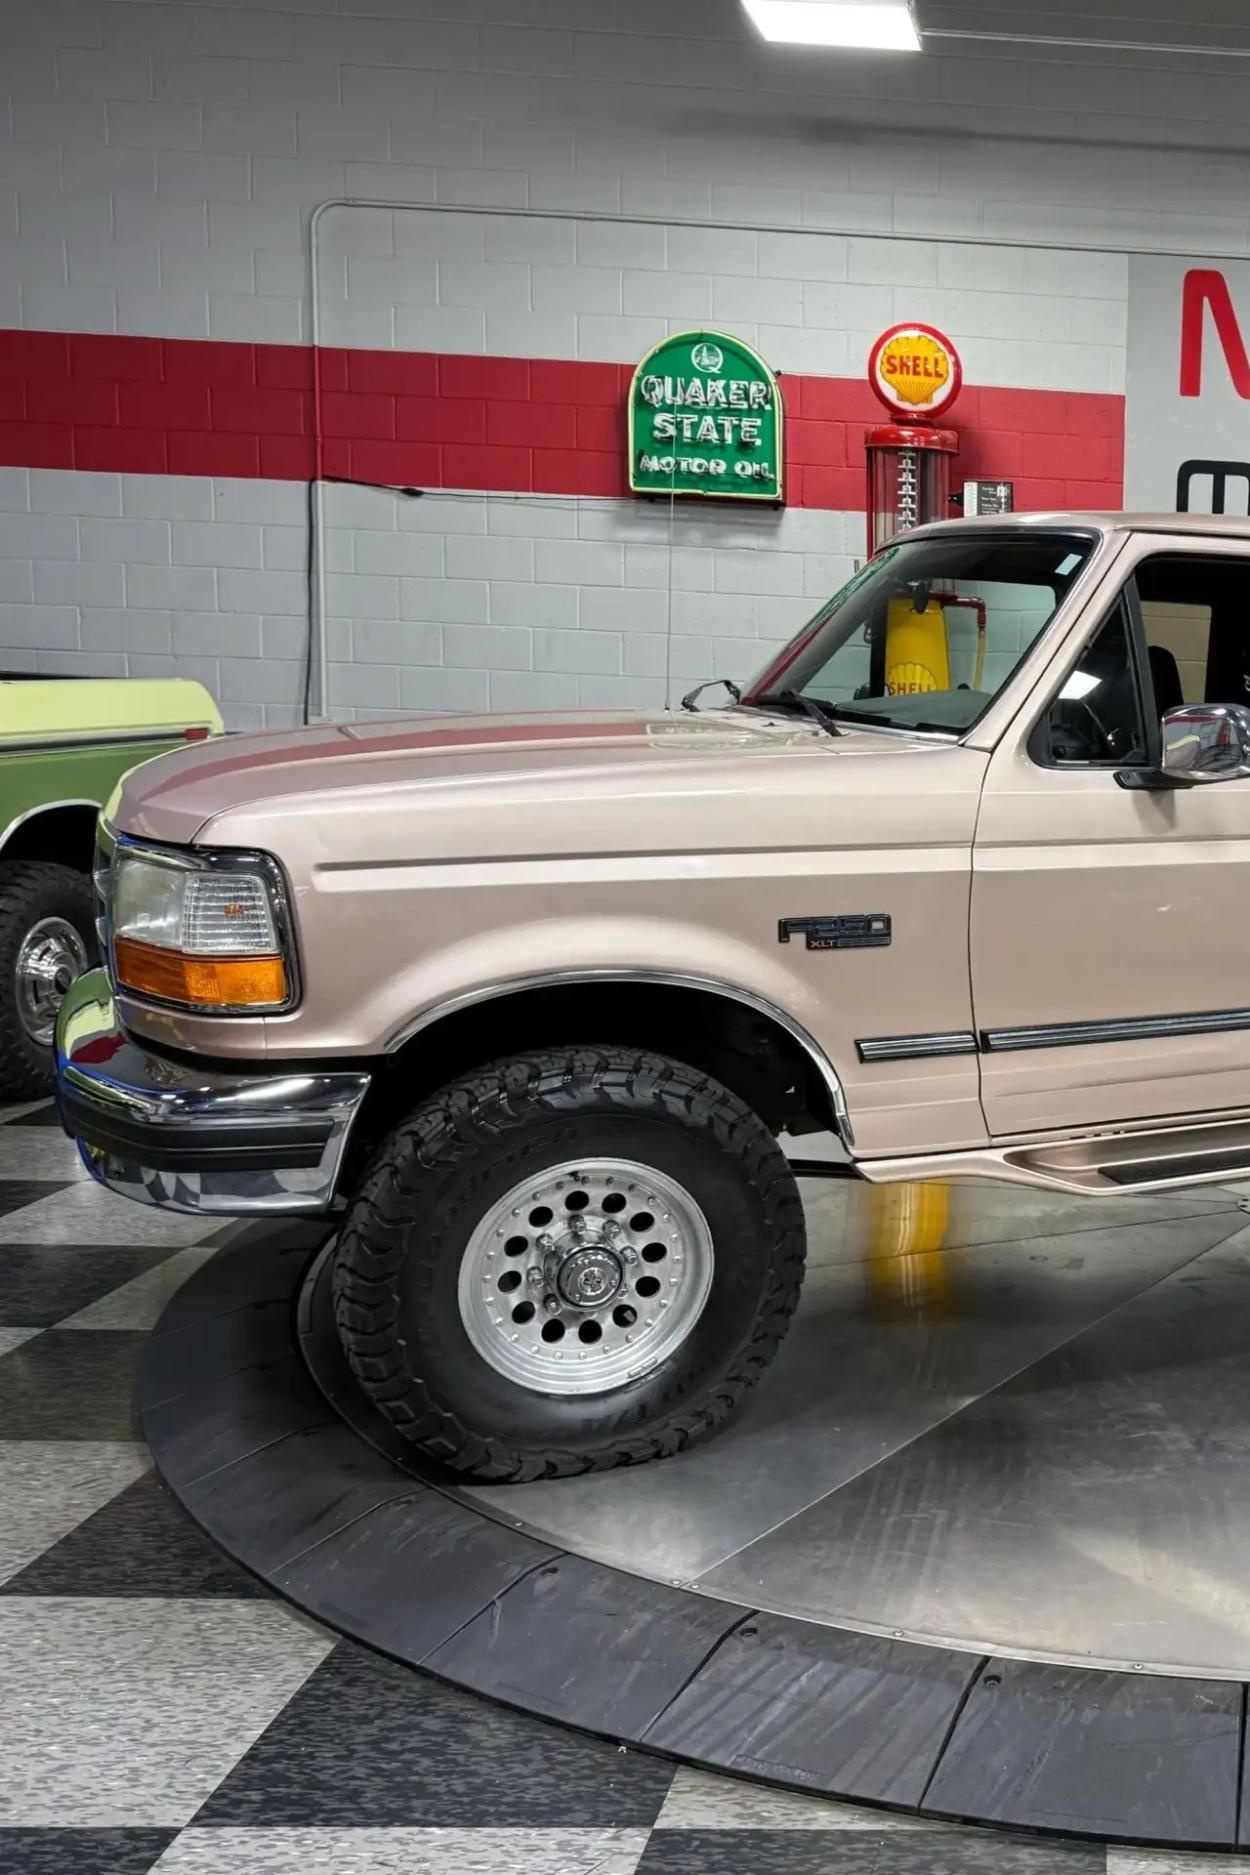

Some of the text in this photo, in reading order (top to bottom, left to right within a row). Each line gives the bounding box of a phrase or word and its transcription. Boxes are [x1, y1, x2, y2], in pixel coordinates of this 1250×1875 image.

[885, 354, 944, 379] SHELL
[640, 375, 773, 410] QUAKER
[653, 412, 762, 446] STATE
[639, 454, 775, 479] MOTOR OIL
[810, 940, 835, 948] XLT
